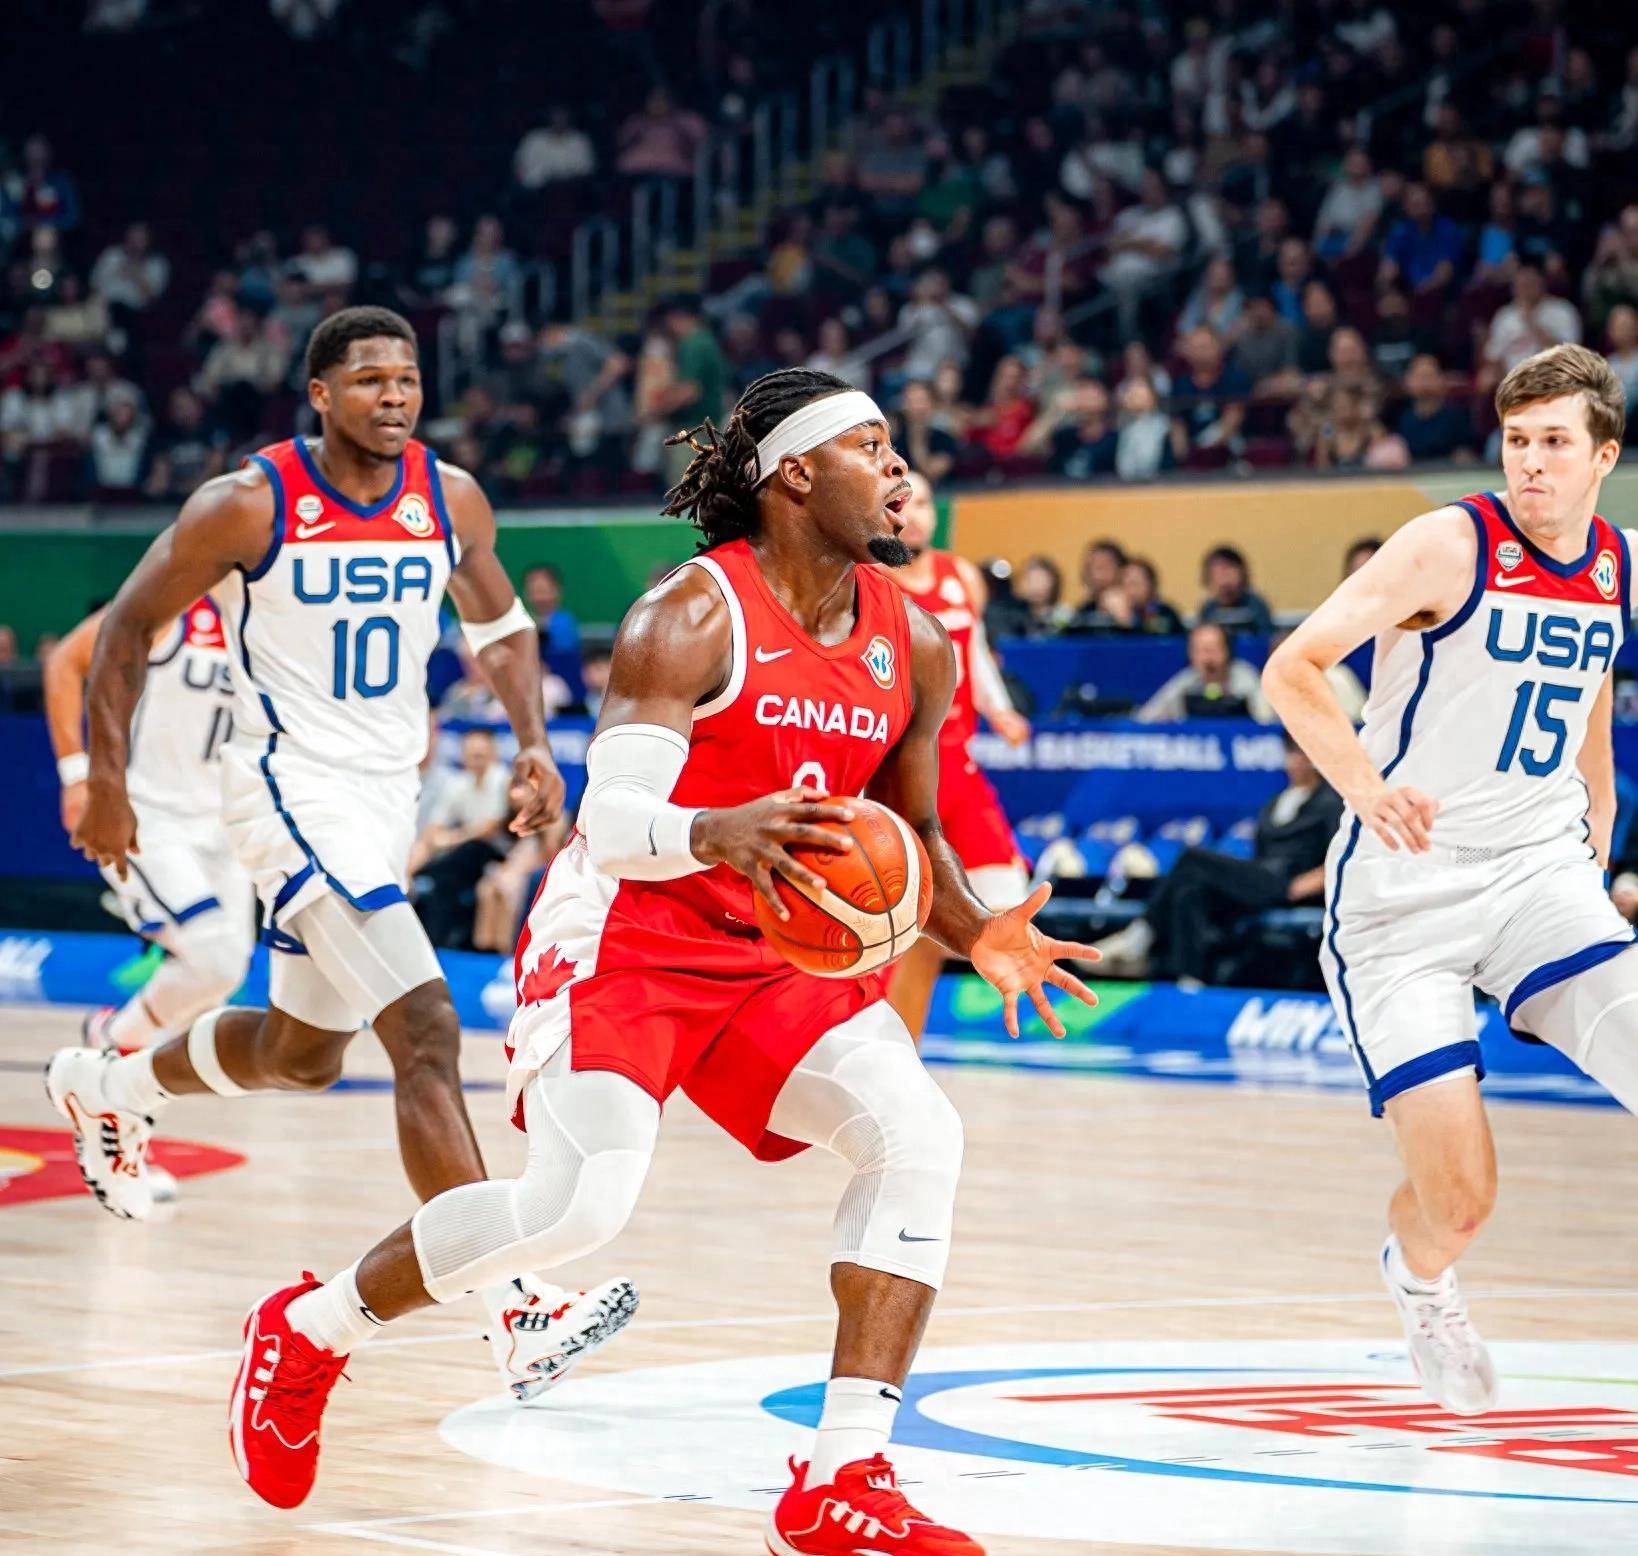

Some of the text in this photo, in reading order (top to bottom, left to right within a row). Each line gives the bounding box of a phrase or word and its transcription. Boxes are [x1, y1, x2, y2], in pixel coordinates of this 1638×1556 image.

[293, 555, 432, 604] USA
[332, 615, 400, 700] 10
[1485, 608, 1614, 673] USA
[184, 656, 235, 696] US
[754, 694, 889, 745] CANADA
[1495, 680, 1583, 777] 15
[1034, 732, 1225, 771] BASKETBALL
